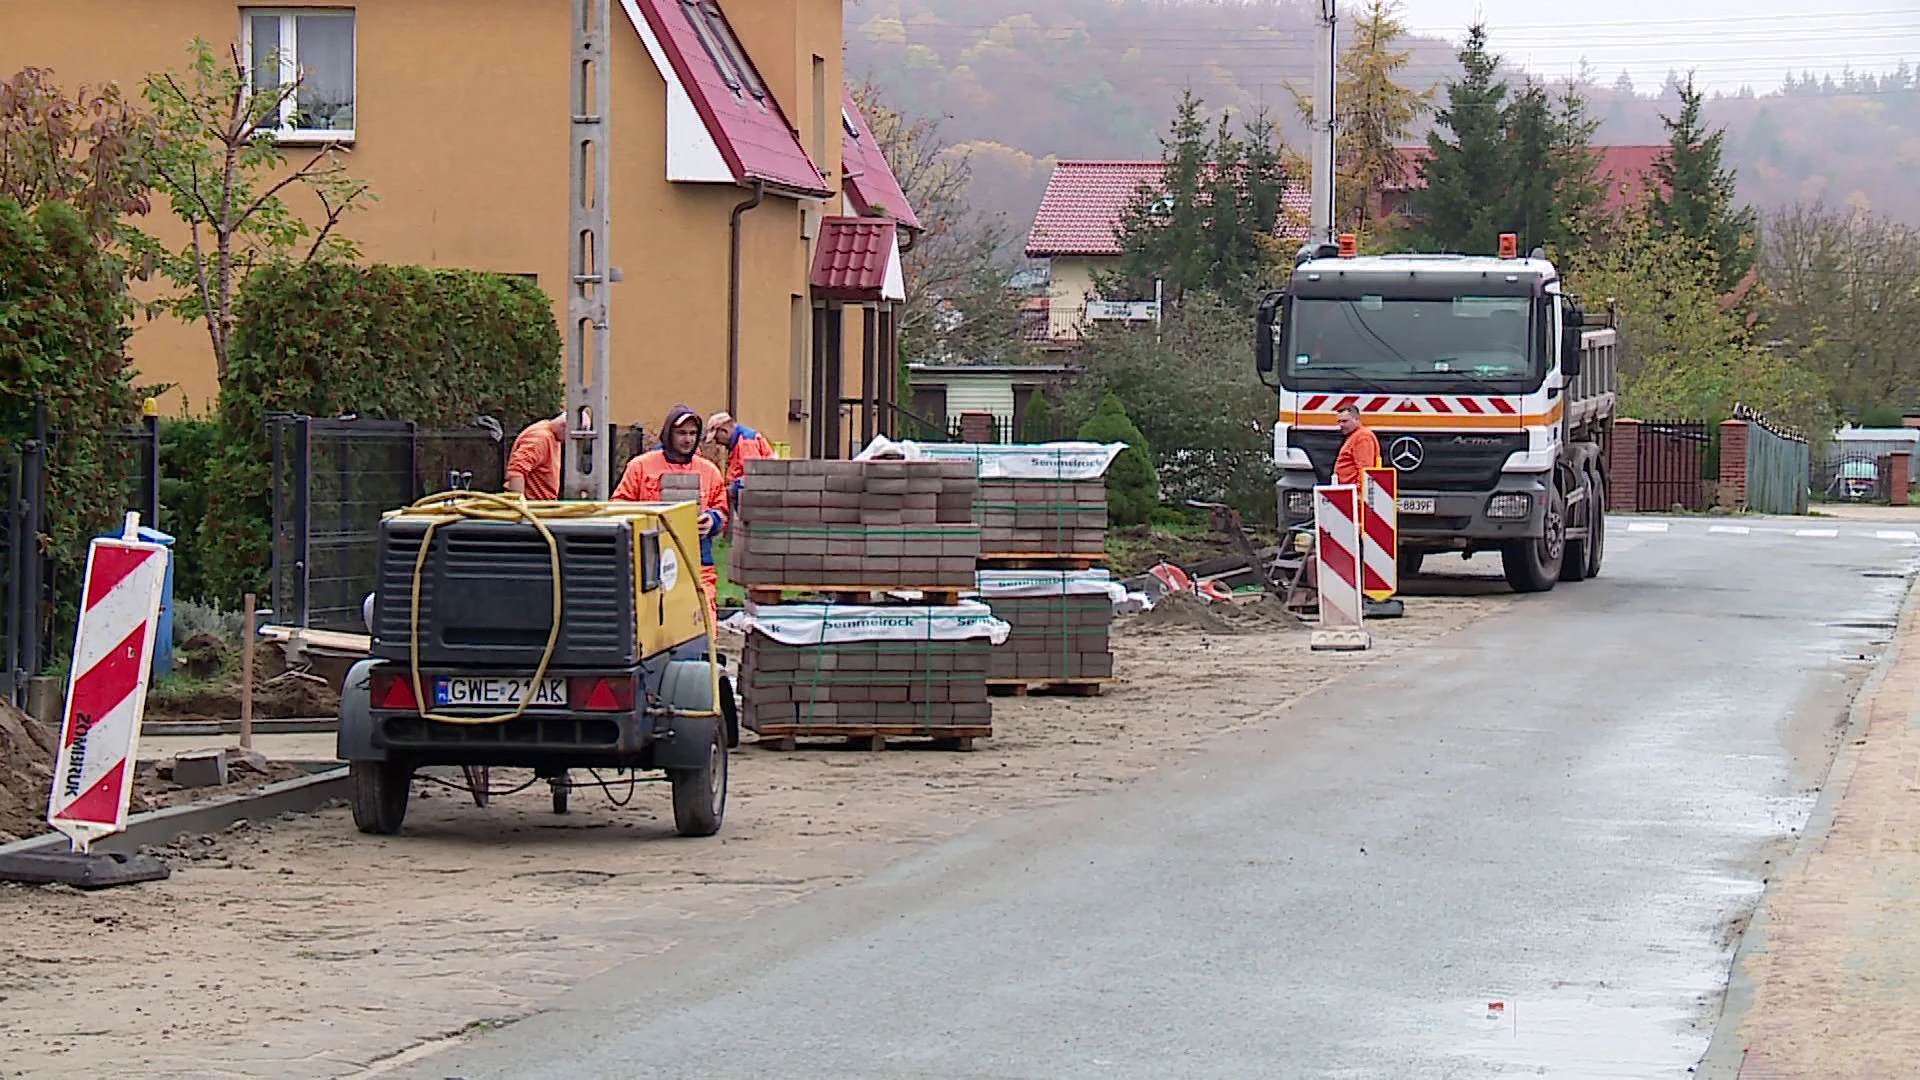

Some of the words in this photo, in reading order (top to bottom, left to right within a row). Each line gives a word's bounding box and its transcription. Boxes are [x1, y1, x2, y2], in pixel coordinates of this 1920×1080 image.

[824, 616, 914, 629] Semmelrock
[451, 679, 499, 702] GWE
[64, 712, 91, 797] ZOMBRUK
